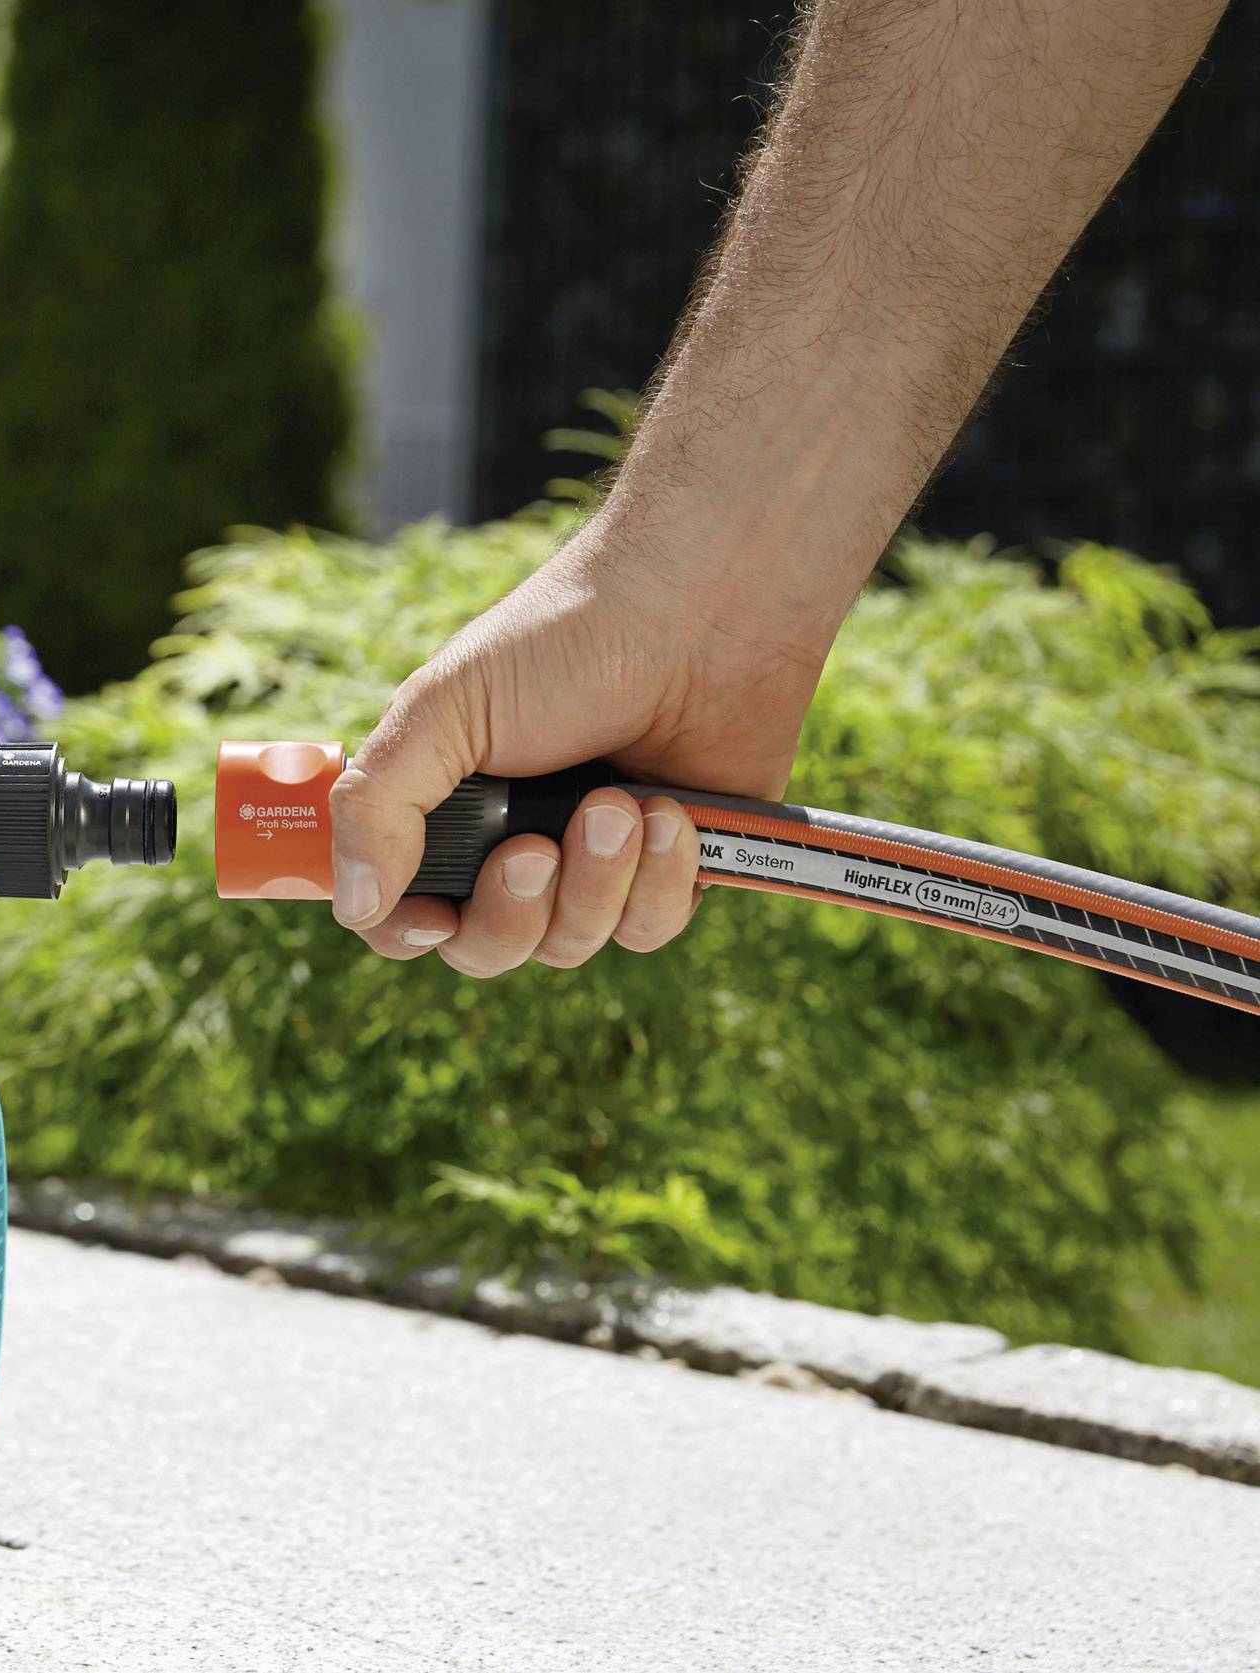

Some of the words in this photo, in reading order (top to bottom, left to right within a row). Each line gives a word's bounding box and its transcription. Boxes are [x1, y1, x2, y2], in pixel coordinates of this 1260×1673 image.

[256, 806, 317, 817] GARDENA
[256, 819, 279, 829] Profi
[281, 819, 318, 830] System
[735, 849, 795, 872] System
[844, 869, 913, 896] HighFLEX
[922, 887, 941, 902] 19
[943, 893, 976, 912] mm
[981, 901, 1016, 919] 3/4"
